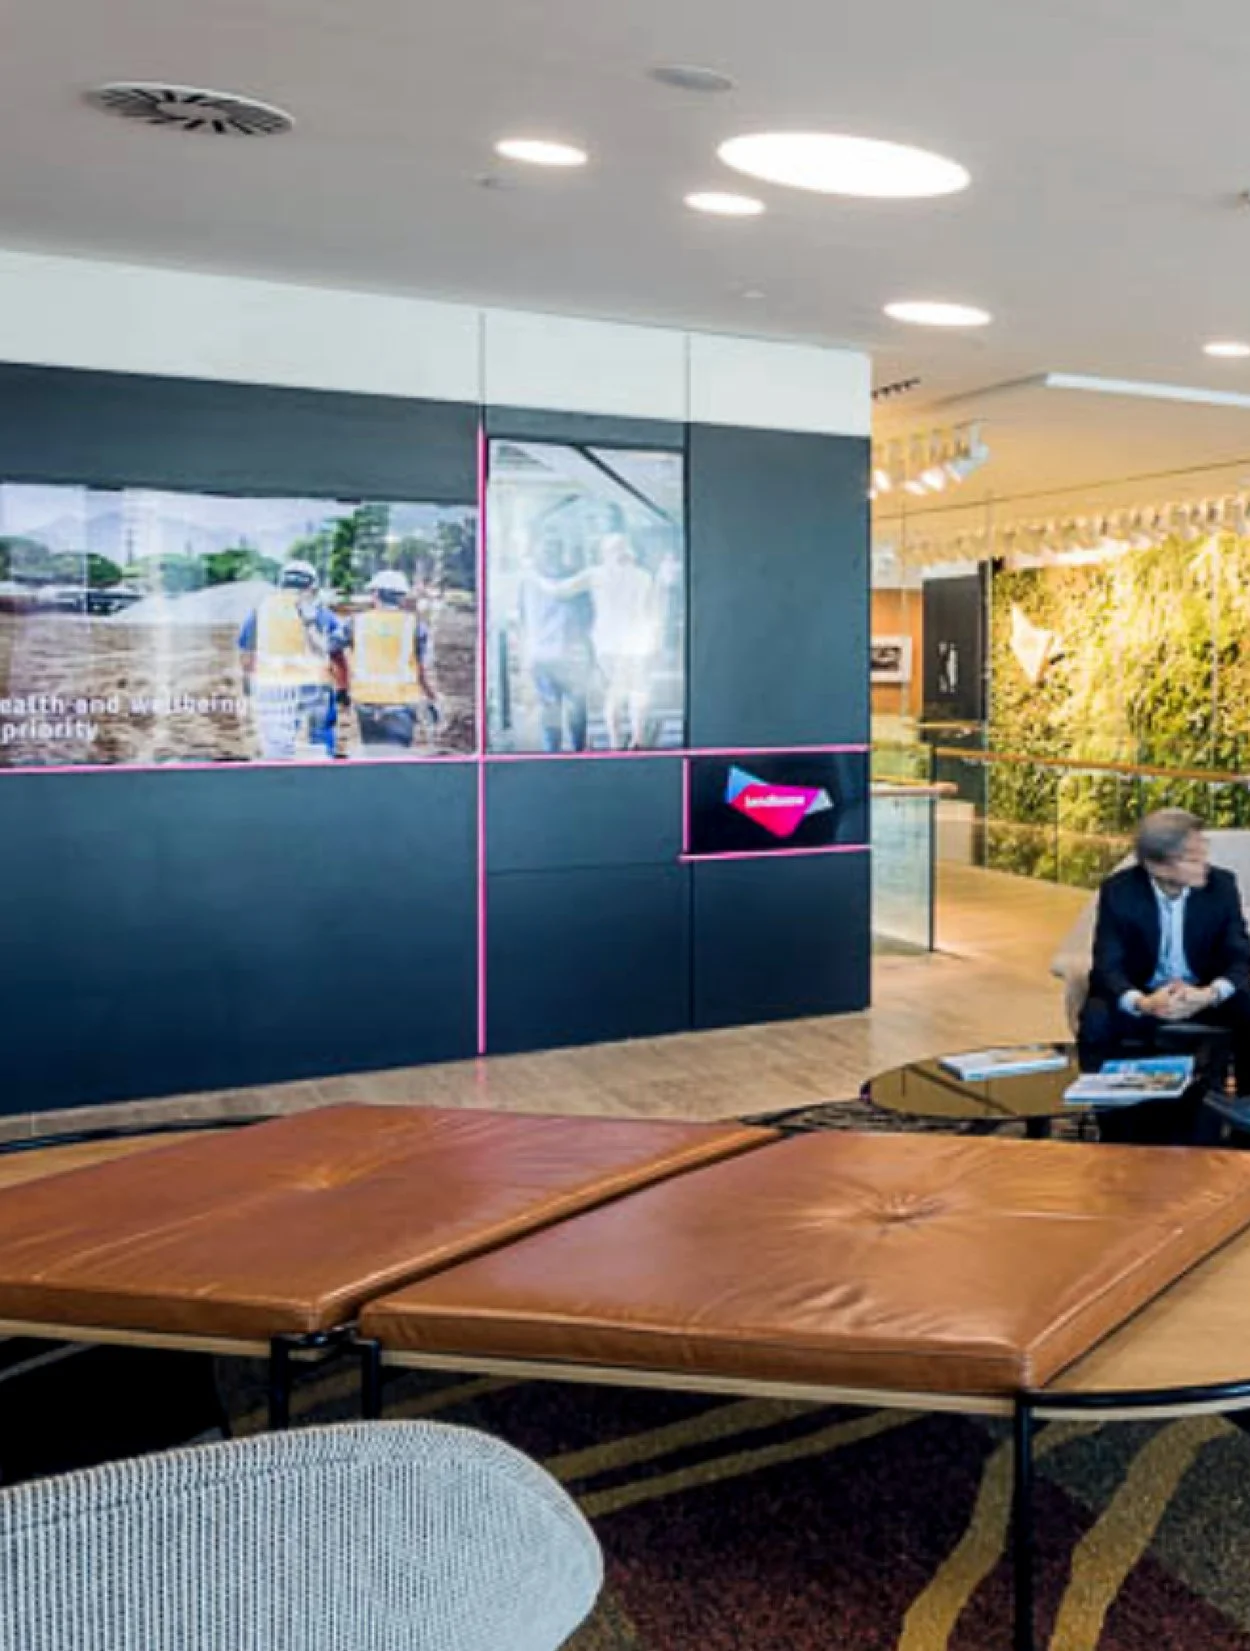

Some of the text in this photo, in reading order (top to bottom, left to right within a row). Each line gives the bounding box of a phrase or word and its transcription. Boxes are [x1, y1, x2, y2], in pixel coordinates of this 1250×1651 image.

[75, 694, 119, 715] and
[129, 693, 248, 718] wellbeing
[2, 717, 99, 744] priority
